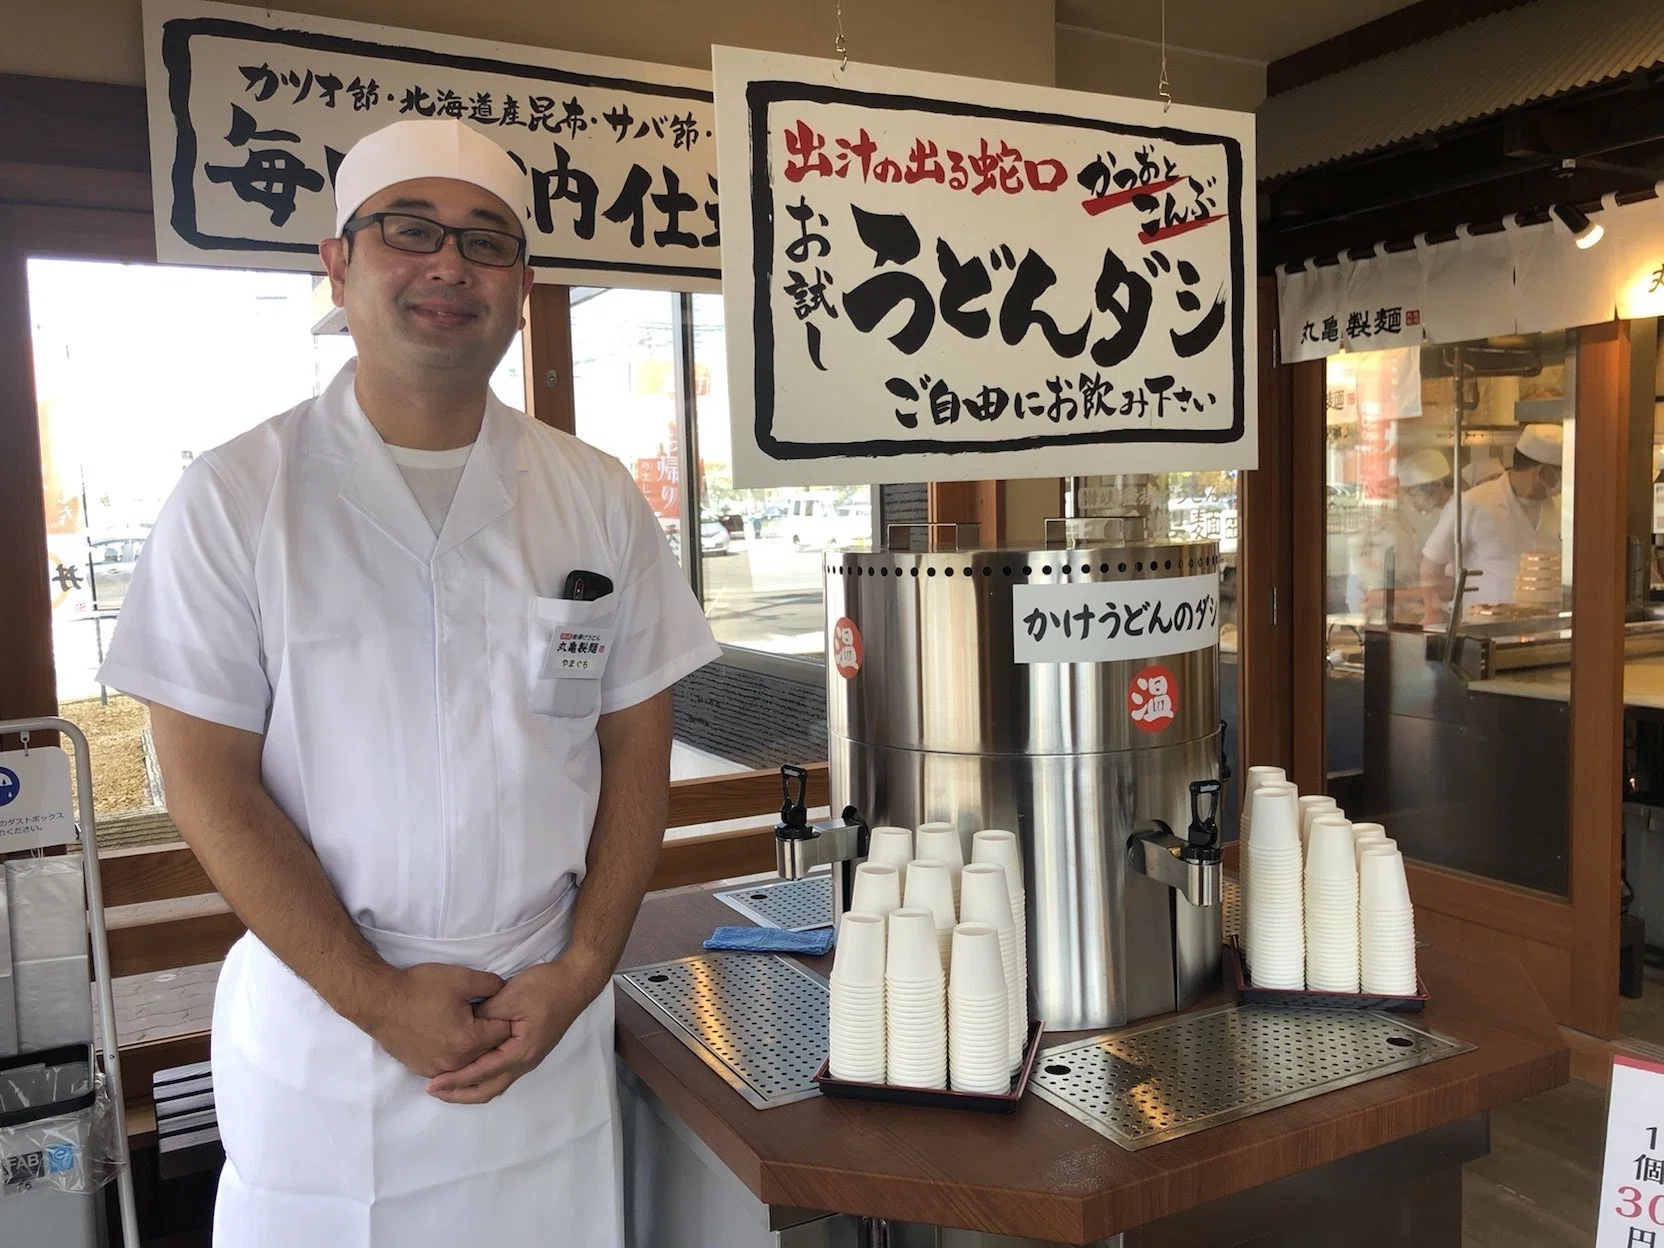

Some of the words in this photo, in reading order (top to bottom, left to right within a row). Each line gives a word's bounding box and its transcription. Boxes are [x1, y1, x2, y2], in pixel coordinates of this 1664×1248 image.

[204, 103, 719, 249] 毎内仕
[784, 119, 1068, 195] 出汁の出る蛇口
[1077, 144, 1180, 198] かつおと
[1131, 175, 1218, 237] こんぶ
[785, 196, 838, 371] お試し
[842, 203, 1227, 368] うどんダシ
[1301, 307, 1402, 345] 丸亀製麺
[885, 372, 1217, 428] ご自由にお飲み下さい
[1022, 594, 1216, 642] かけうどんのダシ
[562, 659, 588, 669] やまぐち
[834, 626, 860, 671] 温
[1131, 675, 1175, 722] 温
